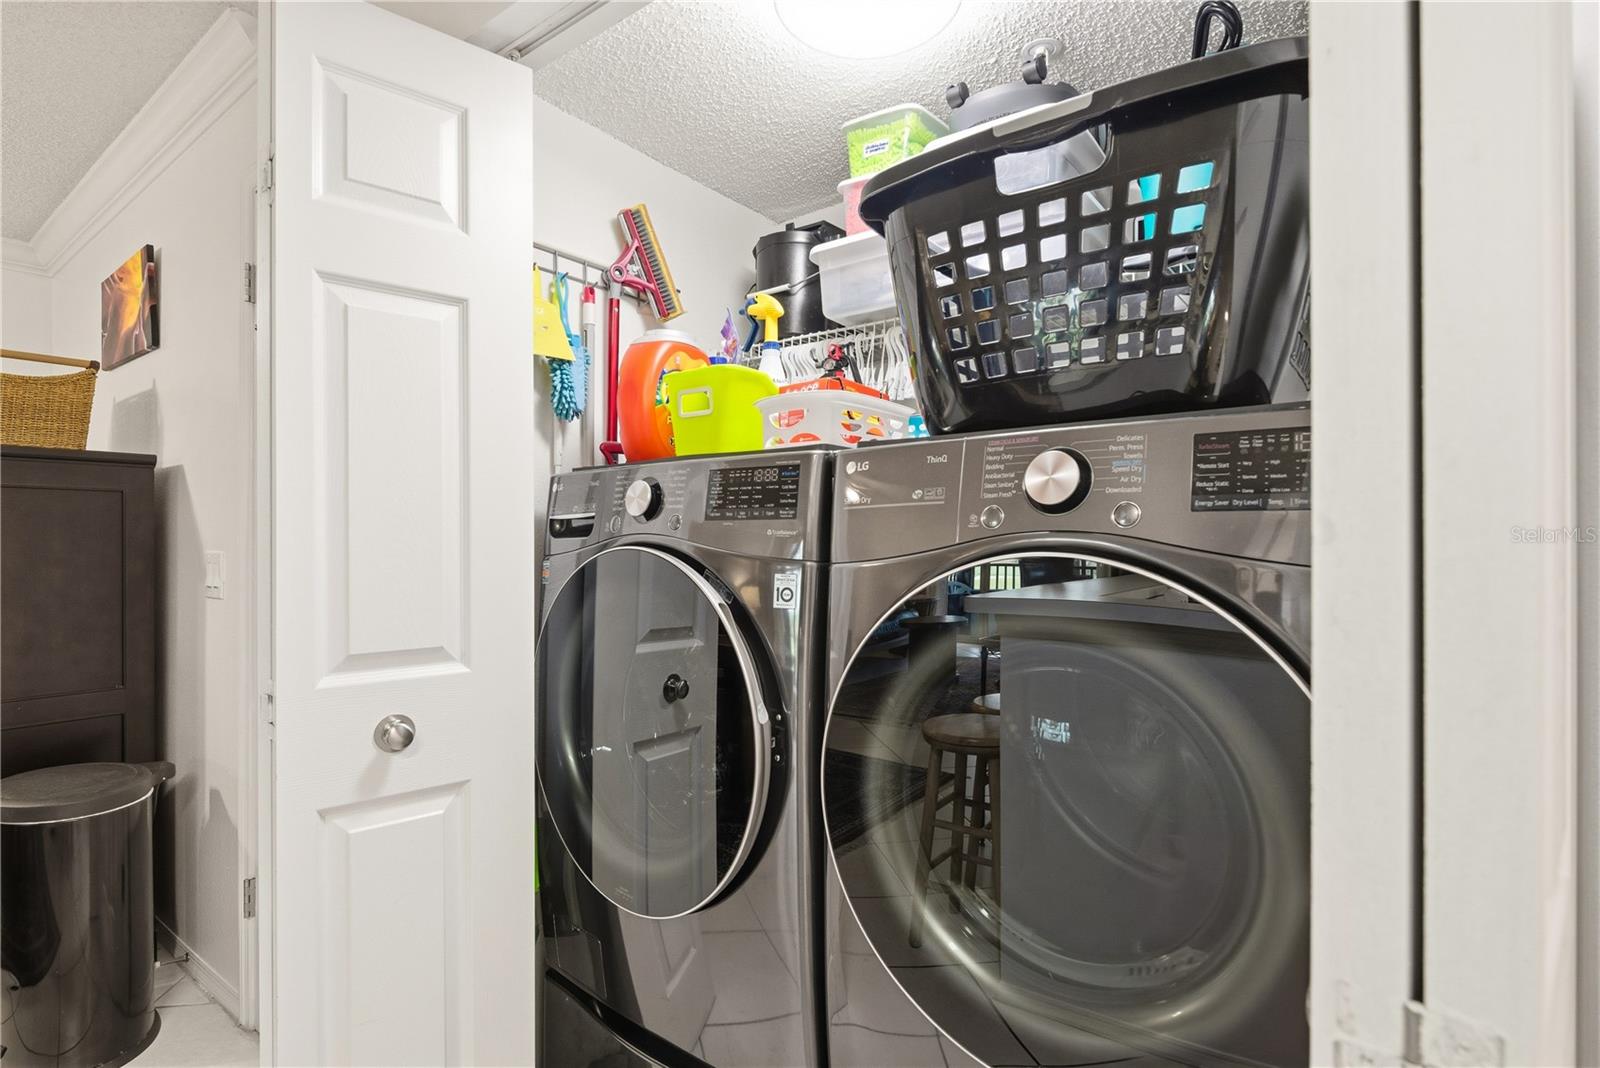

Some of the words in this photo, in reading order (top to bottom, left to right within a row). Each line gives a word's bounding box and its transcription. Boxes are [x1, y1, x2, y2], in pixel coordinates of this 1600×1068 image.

[1116, 434, 1144, 442] Delicates
[926, 454, 948, 464] ThinQ
[856, 461, 870, 472] LG
[1130, 475, 1142, 483] Dry
[860, 496, 872, 504] Dry
[776, 586, 794, 602] 10
